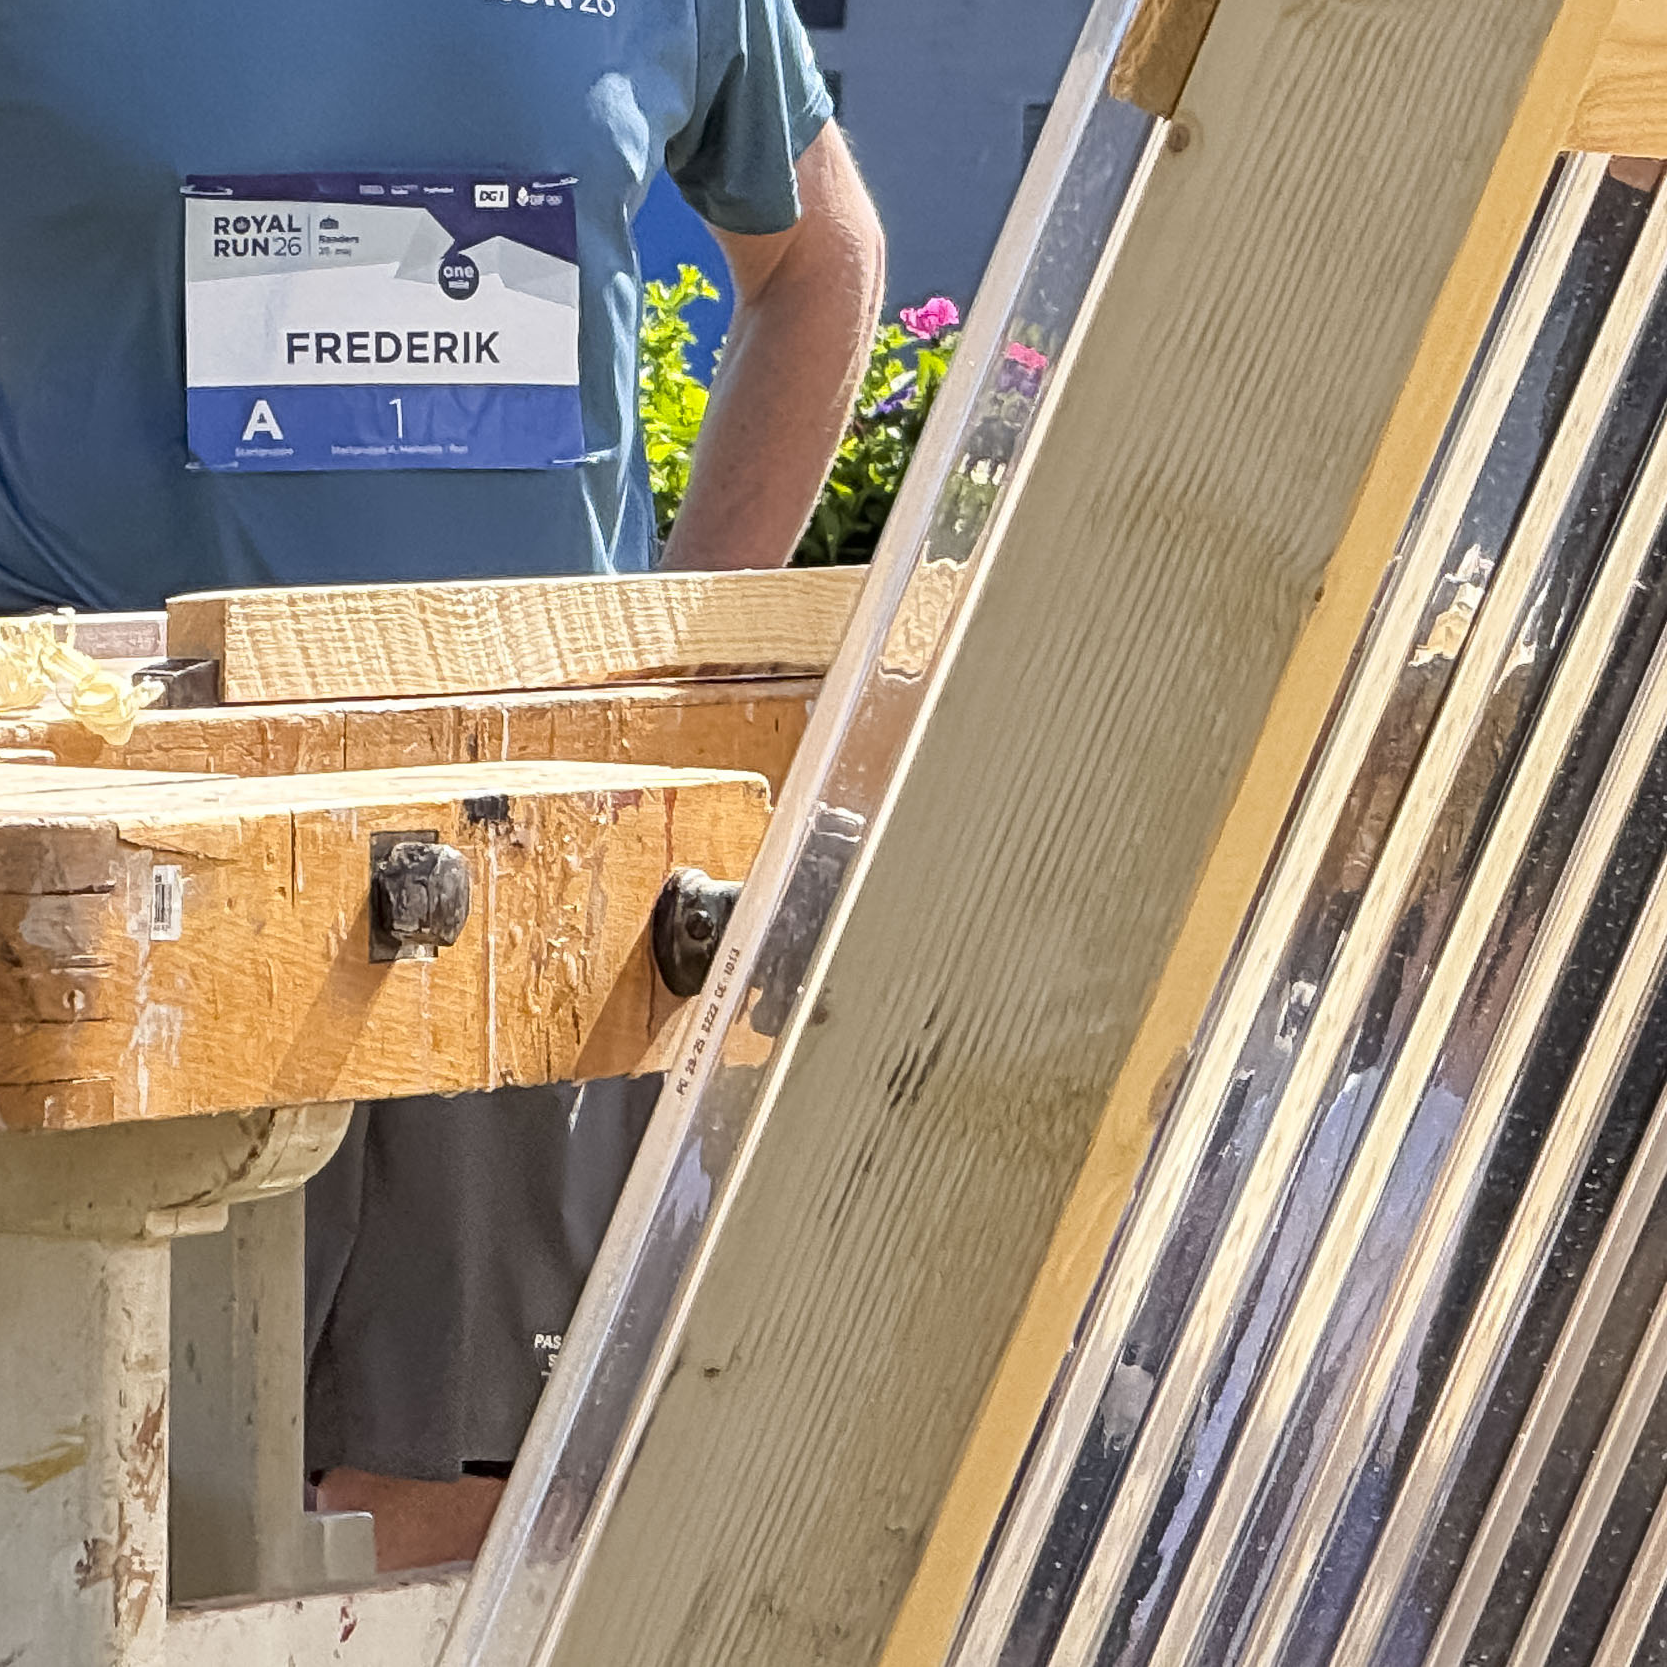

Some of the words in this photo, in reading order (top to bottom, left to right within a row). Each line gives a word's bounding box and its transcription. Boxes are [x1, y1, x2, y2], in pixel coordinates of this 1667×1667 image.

[214, 213, 302, 235] ROYAL
[443, 265, 475, 278] one
[285, 331, 500, 364] FREDERIK
[242, 399, 284, 442] A
[388, 398, 404, 439] 1
[534, 1333, 562, 1350] PAS
